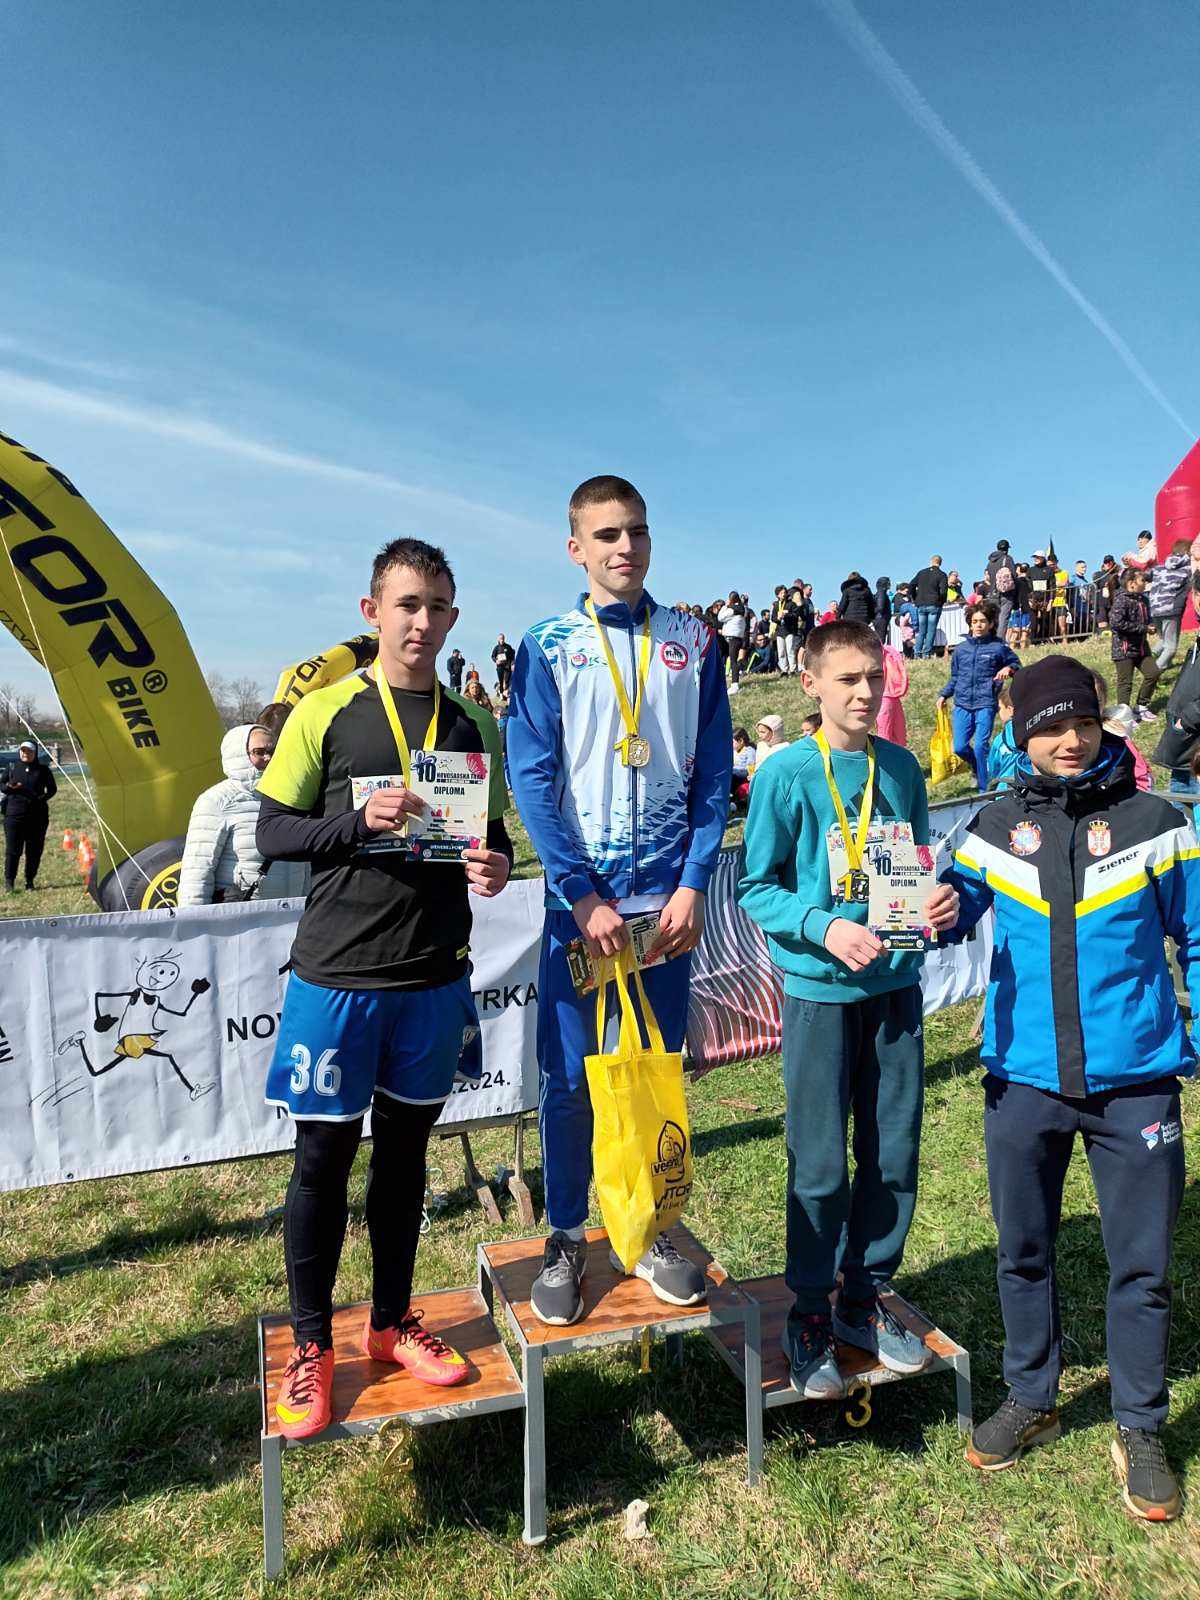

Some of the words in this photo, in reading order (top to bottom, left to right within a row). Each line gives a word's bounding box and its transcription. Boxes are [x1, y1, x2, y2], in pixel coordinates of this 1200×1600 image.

[106, 676, 161, 749] BIKE
[433, 786, 465, 796] DIPLOMA
[890, 879, 917, 887] DIPLOMA
[290, 1043, 342, 1097] 36
[638, 1326, 650, 1374] 1
[844, 1380, 872, 1428] 3
[379, 1416, 414, 1476] 2
